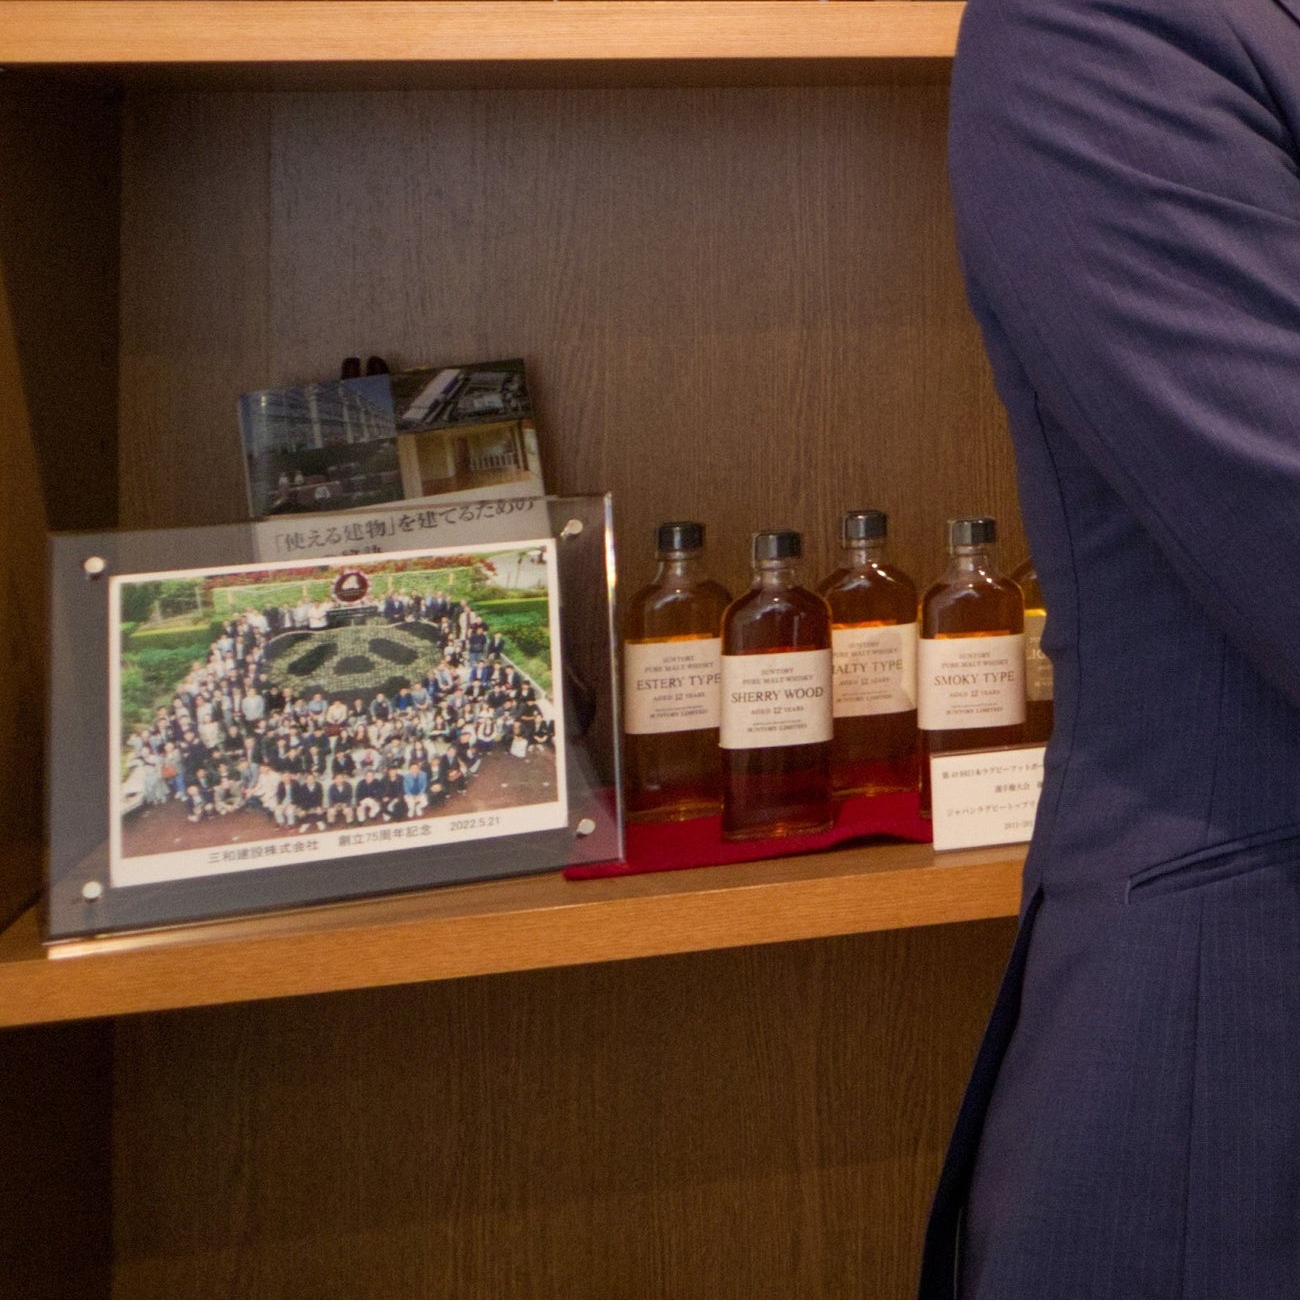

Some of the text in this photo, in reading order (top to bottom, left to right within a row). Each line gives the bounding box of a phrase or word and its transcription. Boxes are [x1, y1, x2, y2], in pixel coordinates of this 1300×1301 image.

[274, 499, 534, 553] 「使える建物」を建てるための
[874, 659, 904, 671] TYPE
[637, 673, 721, 691] ESTERY TYPE
[934, 671, 1015, 686] SMOKY TYPE
[731, 686, 825, 703] SHERRY WOOD
[947, 800, 1037, 817] ジャパンラグビートップリ
[208, 817, 501, 864] 三和建設株式会社 創立75周年記念 2022.5.21
